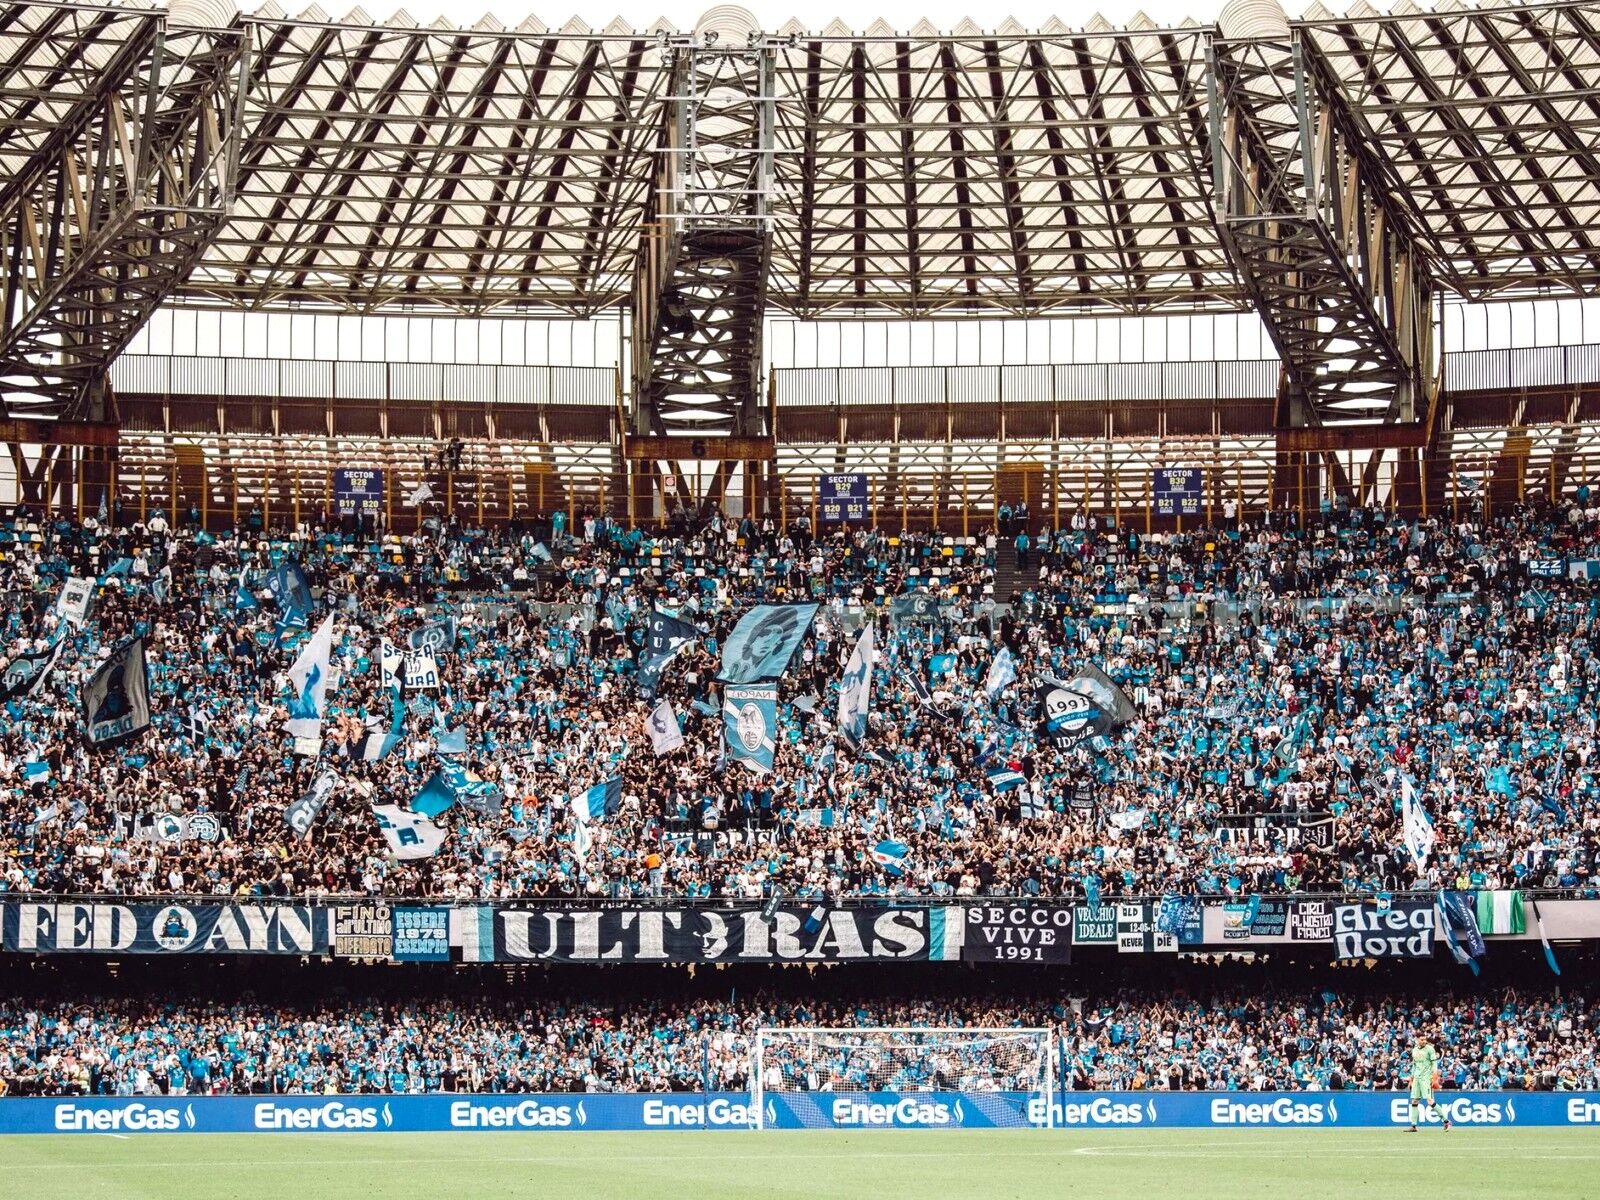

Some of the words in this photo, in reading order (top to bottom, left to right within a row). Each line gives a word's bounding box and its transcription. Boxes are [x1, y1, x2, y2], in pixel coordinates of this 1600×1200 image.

[692, 440, 705, 456] 6
[835, 483, 852, 491] B29
[1169, 477, 1186, 485] B30
[824, 505, 840, 513] B20
[847, 504, 863, 512] B21
[1529, 560, 1562, 569] BZZ
[654, 621, 664, 632] C
[653, 637, 663, 648] U
[1047, 697, 1089, 715] 1991
[337, 906, 391, 920] FINO
[1299, 902, 1325, 915] CIRO
[395, 911, 447, 929] ESSERE
[968, 907, 1071, 926] SECCO
[1292, 914, 1302, 928] AL
[1303, 913, 1334, 928] NOSTRO
[982, 926, 1056, 945] VIVE
[1079, 923, 1114, 938] IDEALE
[1297, 926, 1331, 939] FIANCO
[336, 936, 392, 955] DIFFIDATO
[395, 938, 448, 954] ESEMPIO
[1121, 938, 1143, 947] NEVER
[1157, 936, 1172, 947] DIE
[995, 946, 1044, 960] 1991
[55, 1104, 180, 1129] EnerGas
[254, 1102, 377, 1128] EnerGas
[451, 1101, 571, 1127] EnerGas
[833, 1098, 949, 1123] EnerGas
[1028, 1098, 1142, 1123] EnerGas
[1211, 1098, 1322, 1123] EnerGas
